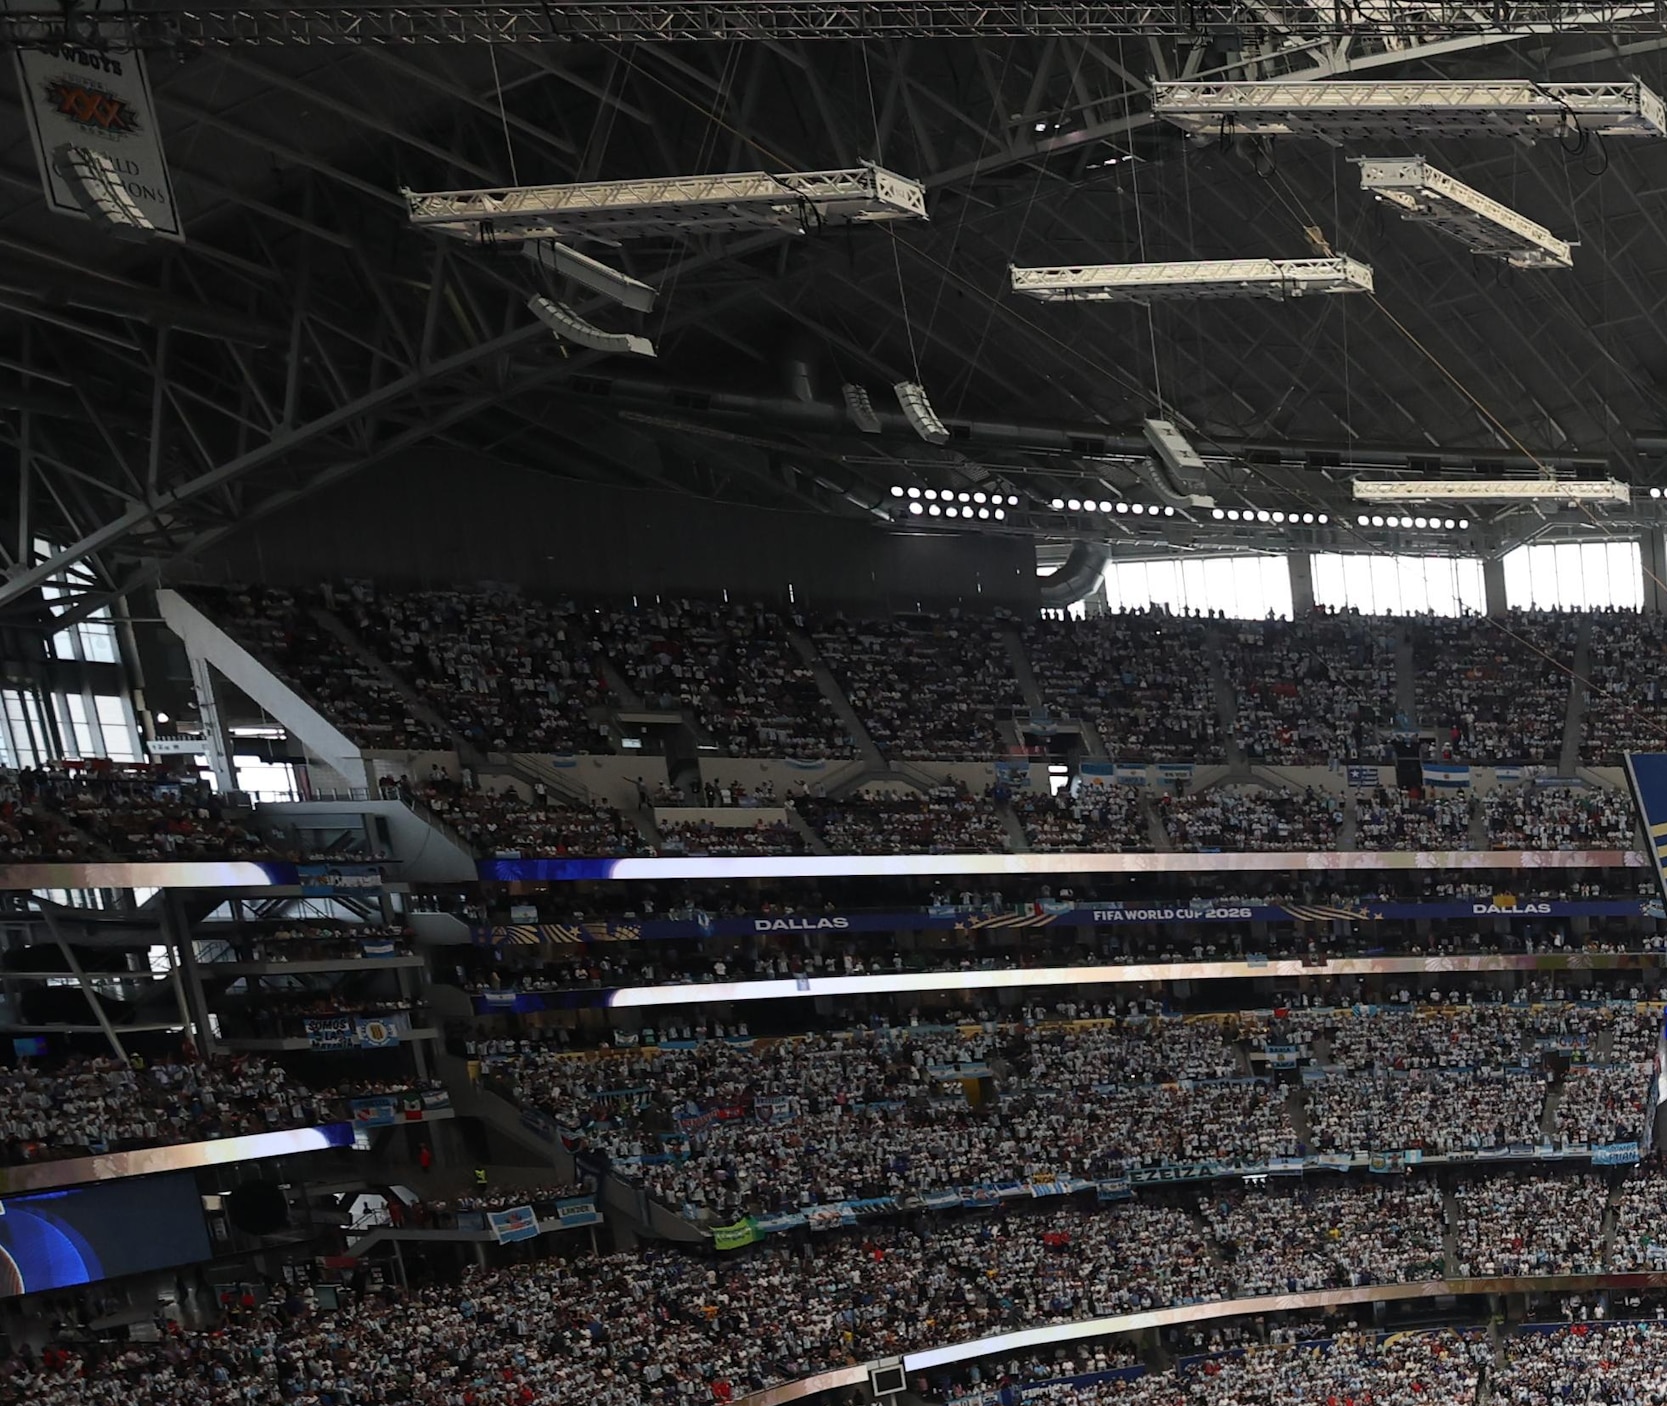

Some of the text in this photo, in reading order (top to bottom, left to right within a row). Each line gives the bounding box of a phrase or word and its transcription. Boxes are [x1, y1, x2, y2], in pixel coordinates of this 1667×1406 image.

[1094, 907, 1252, 921] FIFA WORLD CUP 2026
[1472, 903, 1551, 914] DALLAS
[754, 917, 849, 931] DALLAS
[1130, 1165, 1214, 1182] EZEIZA
